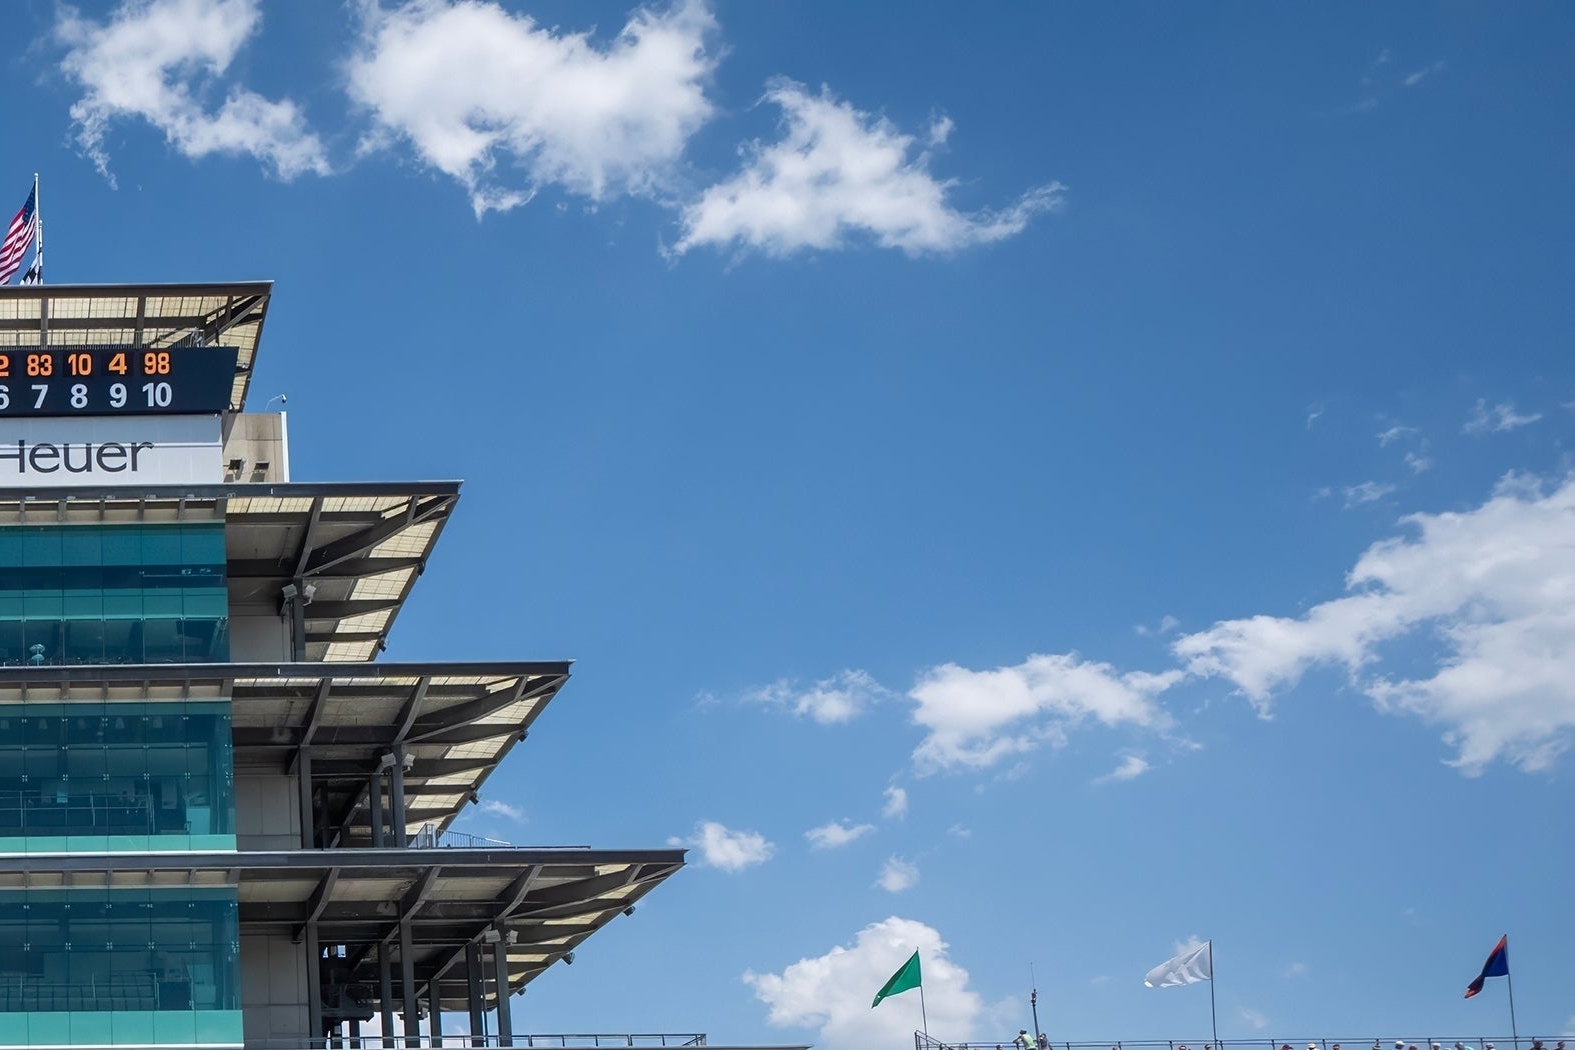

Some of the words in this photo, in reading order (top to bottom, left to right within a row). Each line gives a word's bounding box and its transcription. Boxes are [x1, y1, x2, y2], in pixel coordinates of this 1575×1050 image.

[27, 354, 53, 377] 83
[68, 353, 92, 376] 10
[108, 353, 127, 375] 4
[144, 352, 170, 375] 98
[31, 384, 49, 409] 7
[70, 383, 88, 409] 8
[109, 382, 127, 408] 9
[142, 382, 172, 408] 10
